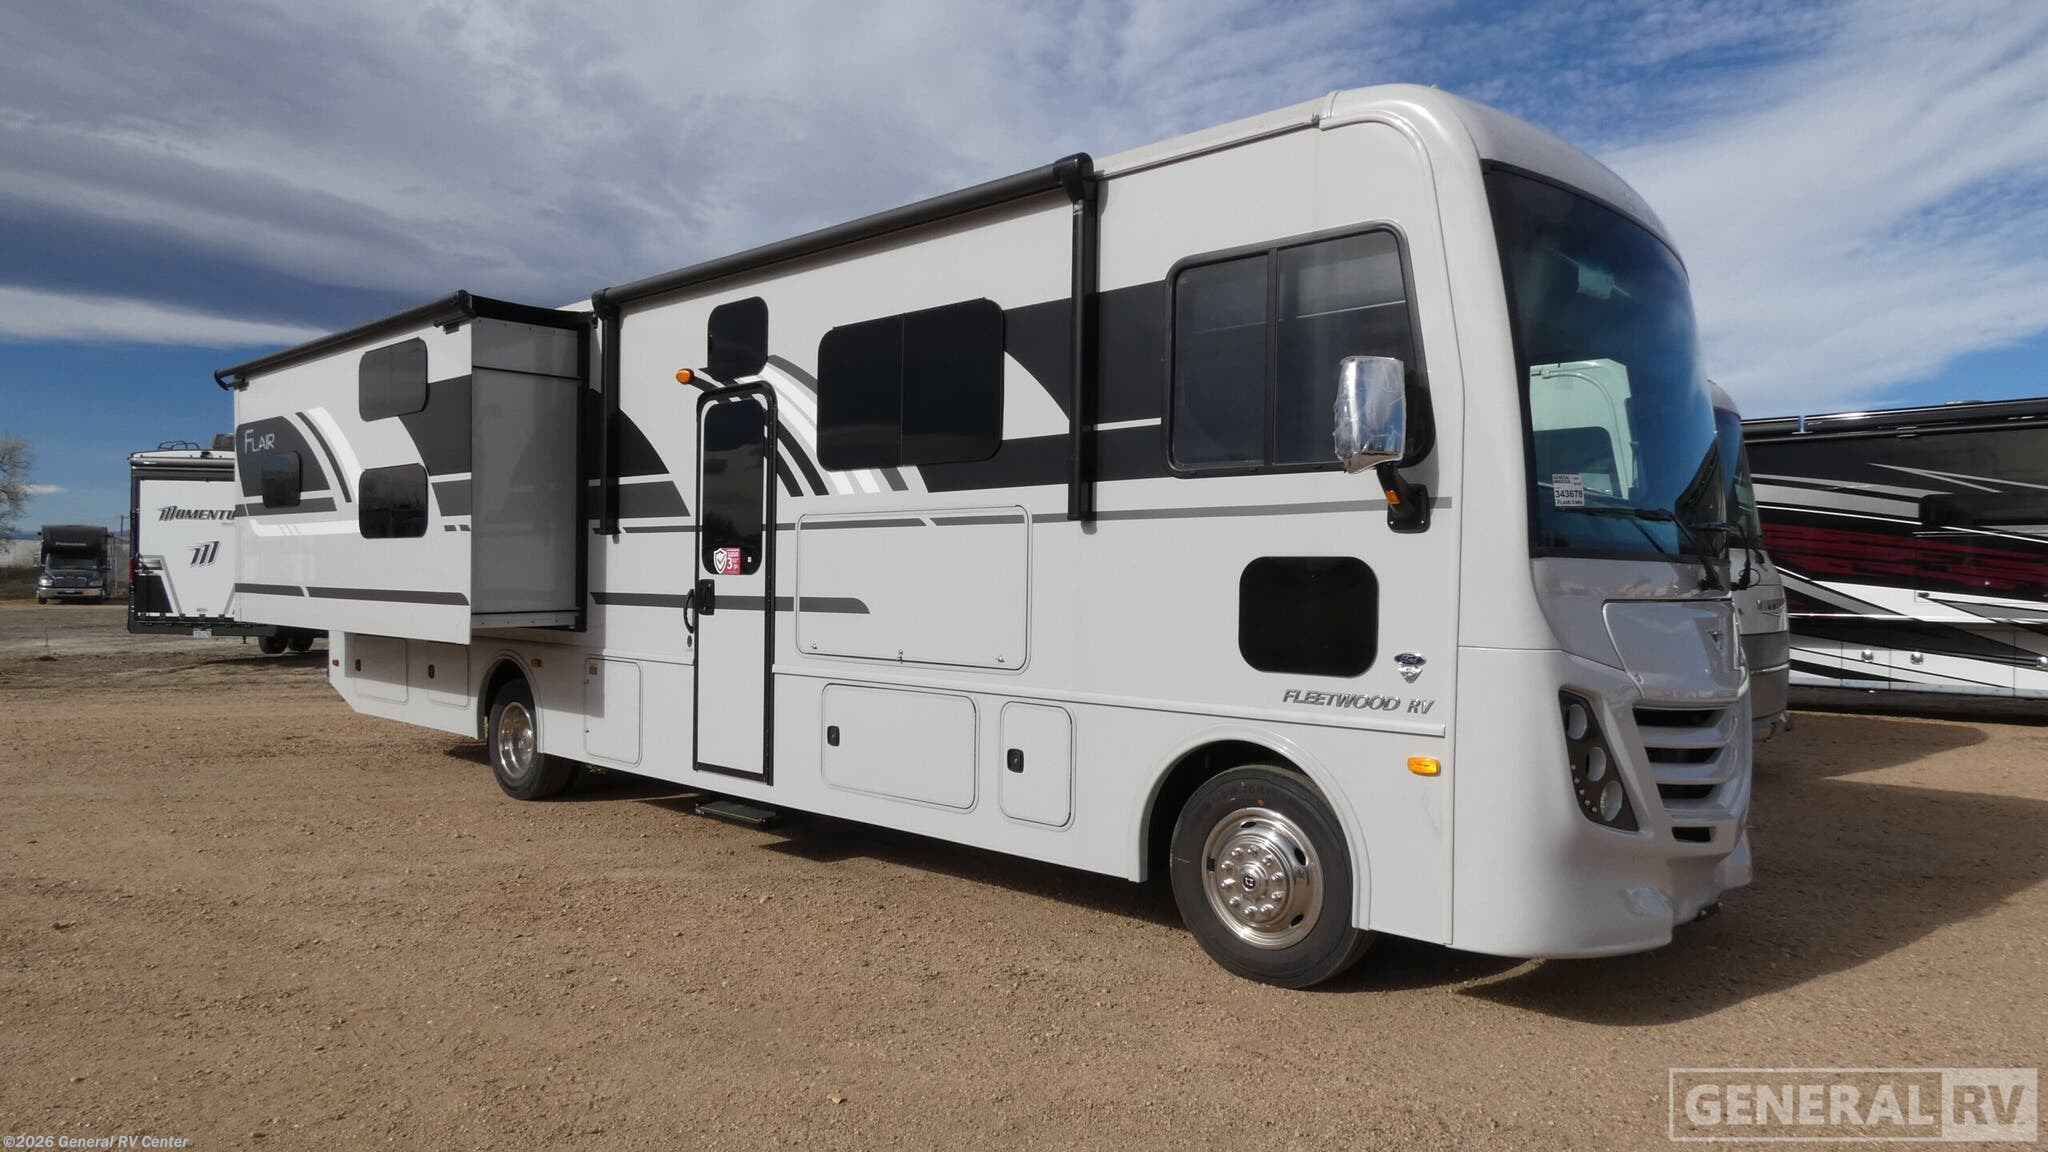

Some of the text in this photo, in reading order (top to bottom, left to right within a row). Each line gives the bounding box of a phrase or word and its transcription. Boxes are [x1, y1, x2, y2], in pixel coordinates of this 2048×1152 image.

[158, 505, 236, 521] MOMENTU
[1282, 688, 1435, 714] FLEETWOOD RV
